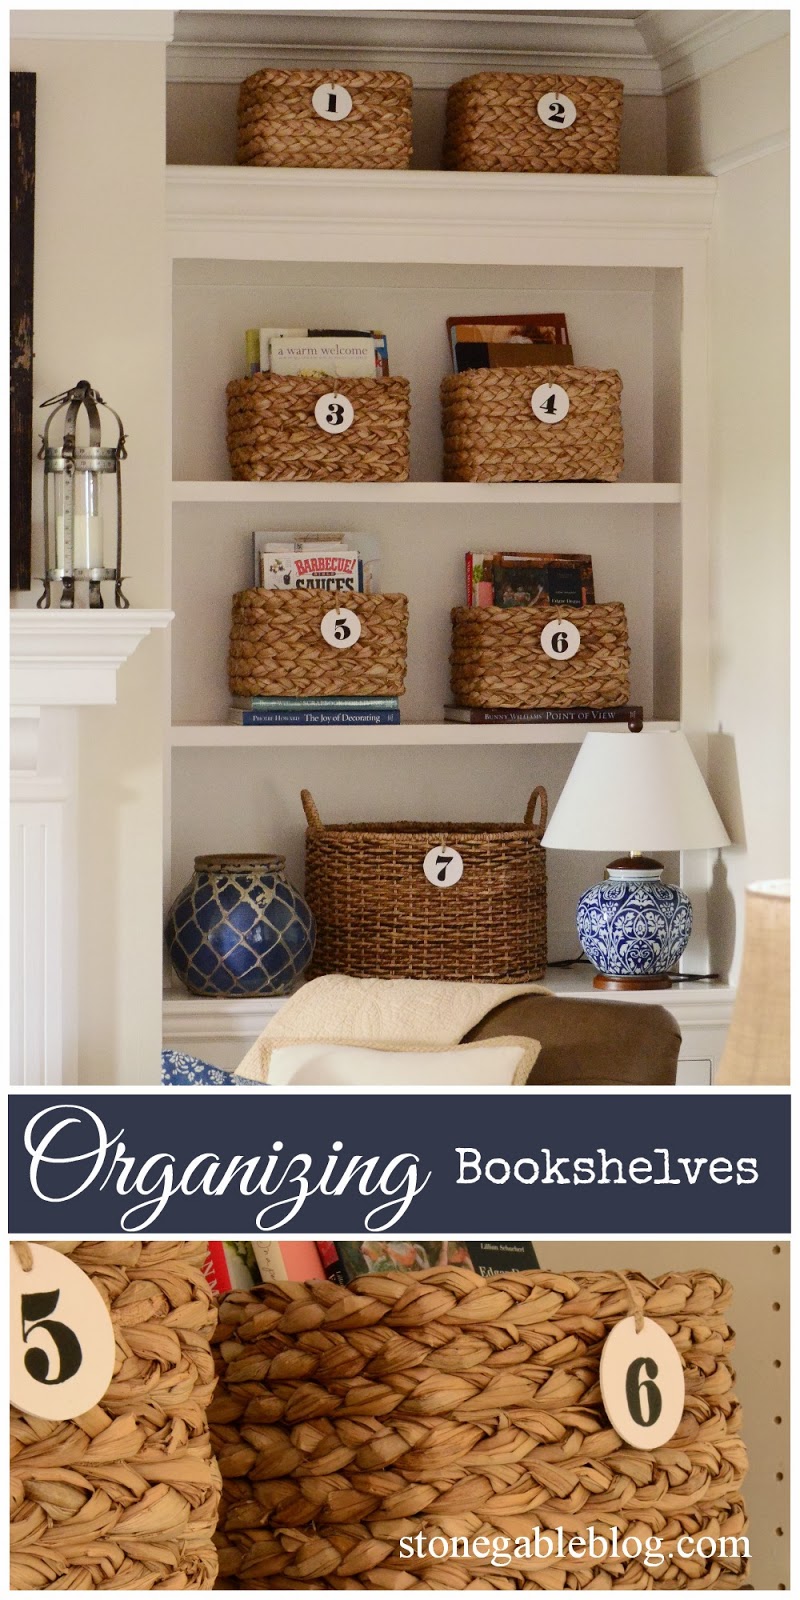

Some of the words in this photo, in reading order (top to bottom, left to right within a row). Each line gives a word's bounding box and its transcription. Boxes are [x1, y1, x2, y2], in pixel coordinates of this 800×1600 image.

[325, 93, 338, 114] 1
[548, 102, 566, 124] 2
[287, 347, 318, 355] warm
[321, 344, 368, 355] welcome
[326, 403, 345, 426] 3
[539, 393, 558, 416] 4
[294, 557, 356, 576] BARBECUE!
[334, 618, 351, 641] 5
[550, 631, 569, 654] 6
[304, 713, 320, 722] The
[320, 713, 332, 724] Joy
[332, 713, 342, 722] of
[341, 713, 381, 724] Decorating
[546, 711, 576, 720] POINT
[577, 711, 590, 720] OF
[591, 710, 616, 719] VIEW
[435, 854, 454, 882] 7
[21, 1288, 83, 1385] 5
[625, 1357, 662, 1428] 6
